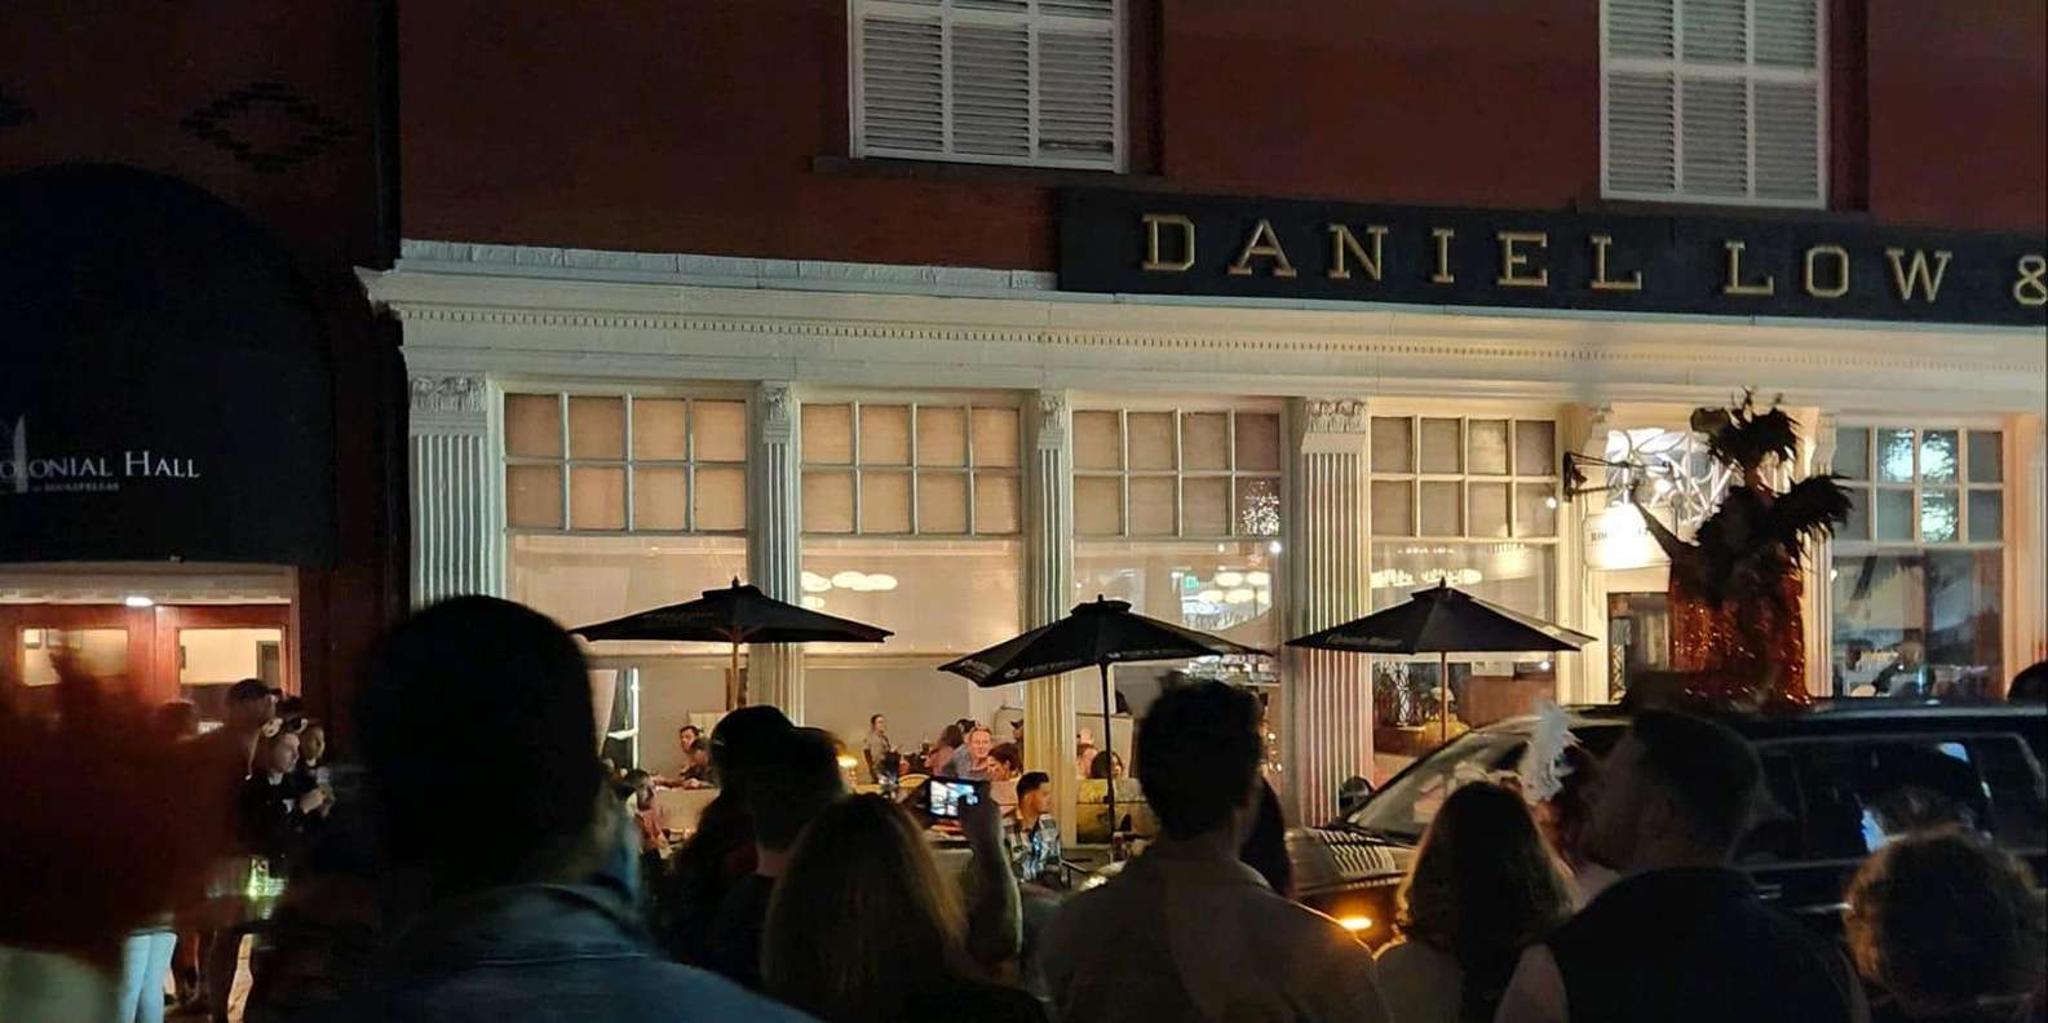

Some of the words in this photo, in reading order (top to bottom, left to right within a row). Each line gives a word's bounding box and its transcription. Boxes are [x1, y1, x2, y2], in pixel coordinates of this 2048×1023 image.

[1142, 213, 1642, 290] DANIEL
[1723, 240, 1953, 302] LOW
[2013, 254, 2047, 305] &
